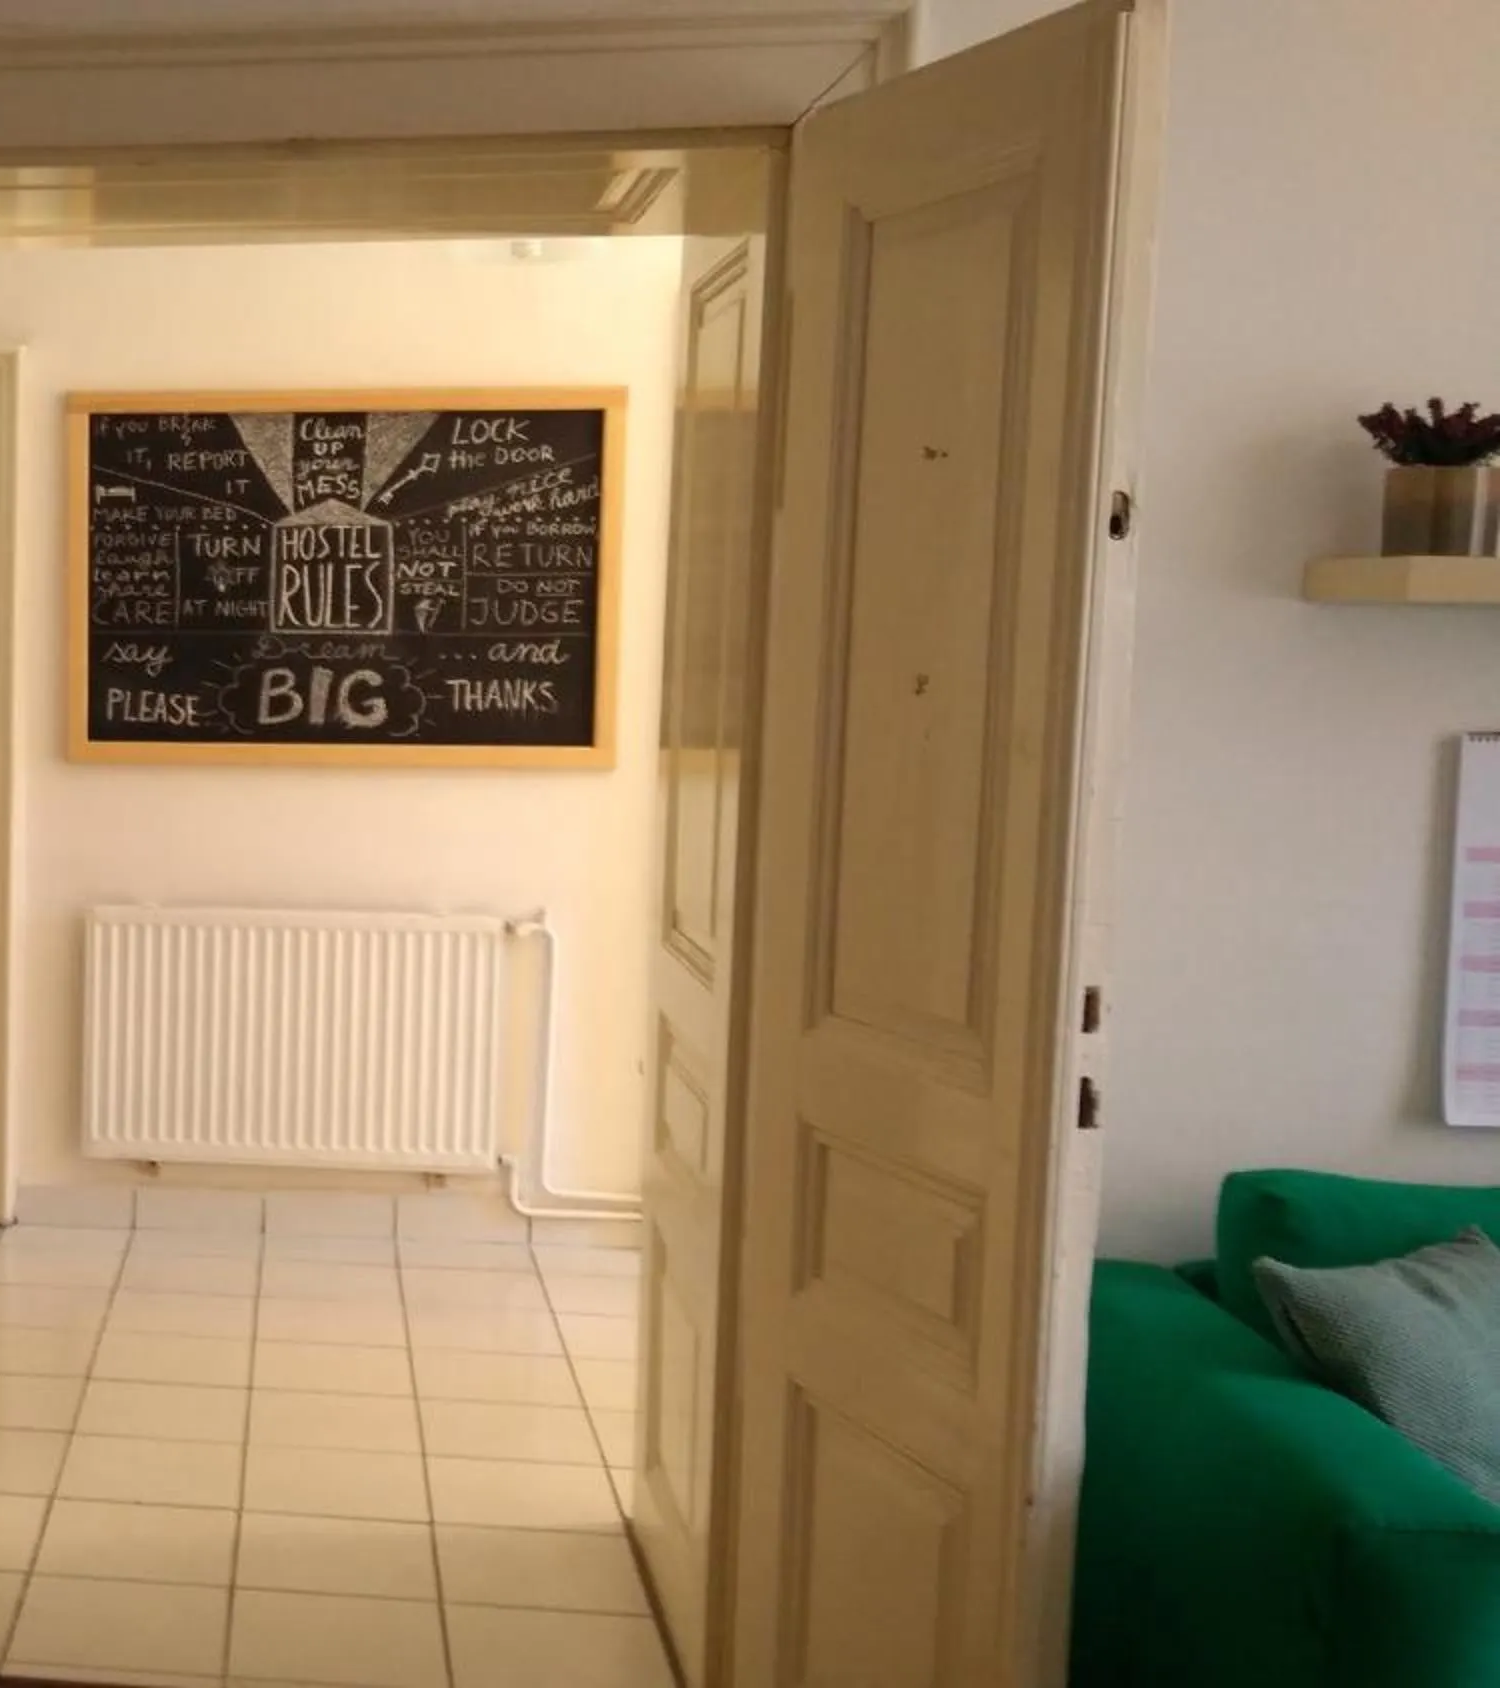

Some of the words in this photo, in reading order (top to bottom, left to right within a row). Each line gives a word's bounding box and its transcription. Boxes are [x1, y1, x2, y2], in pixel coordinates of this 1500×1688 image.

[299, 417, 364, 441] Clean
[450, 417, 530, 445] LOCK
[166, 449, 248, 472] REPORT
[312, 441, 345, 456] UP
[493, 444, 556, 465] DOOR
[225, 478, 250, 496] IT
[297, 474, 361, 508] MESS
[93, 505, 152, 522] MAKE
[155, 505, 197, 522] YOUR
[202, 504, 237, 522] BED
[186, 532, 262, 559] TURN
[281, 524, 382, 562] HOSTEL
[407, 528, 452, 547] YOU
[396, 545, 462, 561] SHALL
[472, 541, 593, 569] RETURN
[396, 560, 459, 580] NOT
[276, 562, 386, 629] RULES
[398, 581, 461, 597] STEAL
[496, 578, 530, 595] DO
[534, 577, 582, 597] NOT
[92, 599, 174, 625] CARE
[182, 599, 211, 618] AT
[214, 599, 270, 618] NIGHT
[467, 597, 585, 627] JUDGE
[102, 639, 175, 679] say
[105, 685, 201, 727] PLEASE
[256, 665, 389, 730] BIG
[445, 677, 561, 716] THANKS
